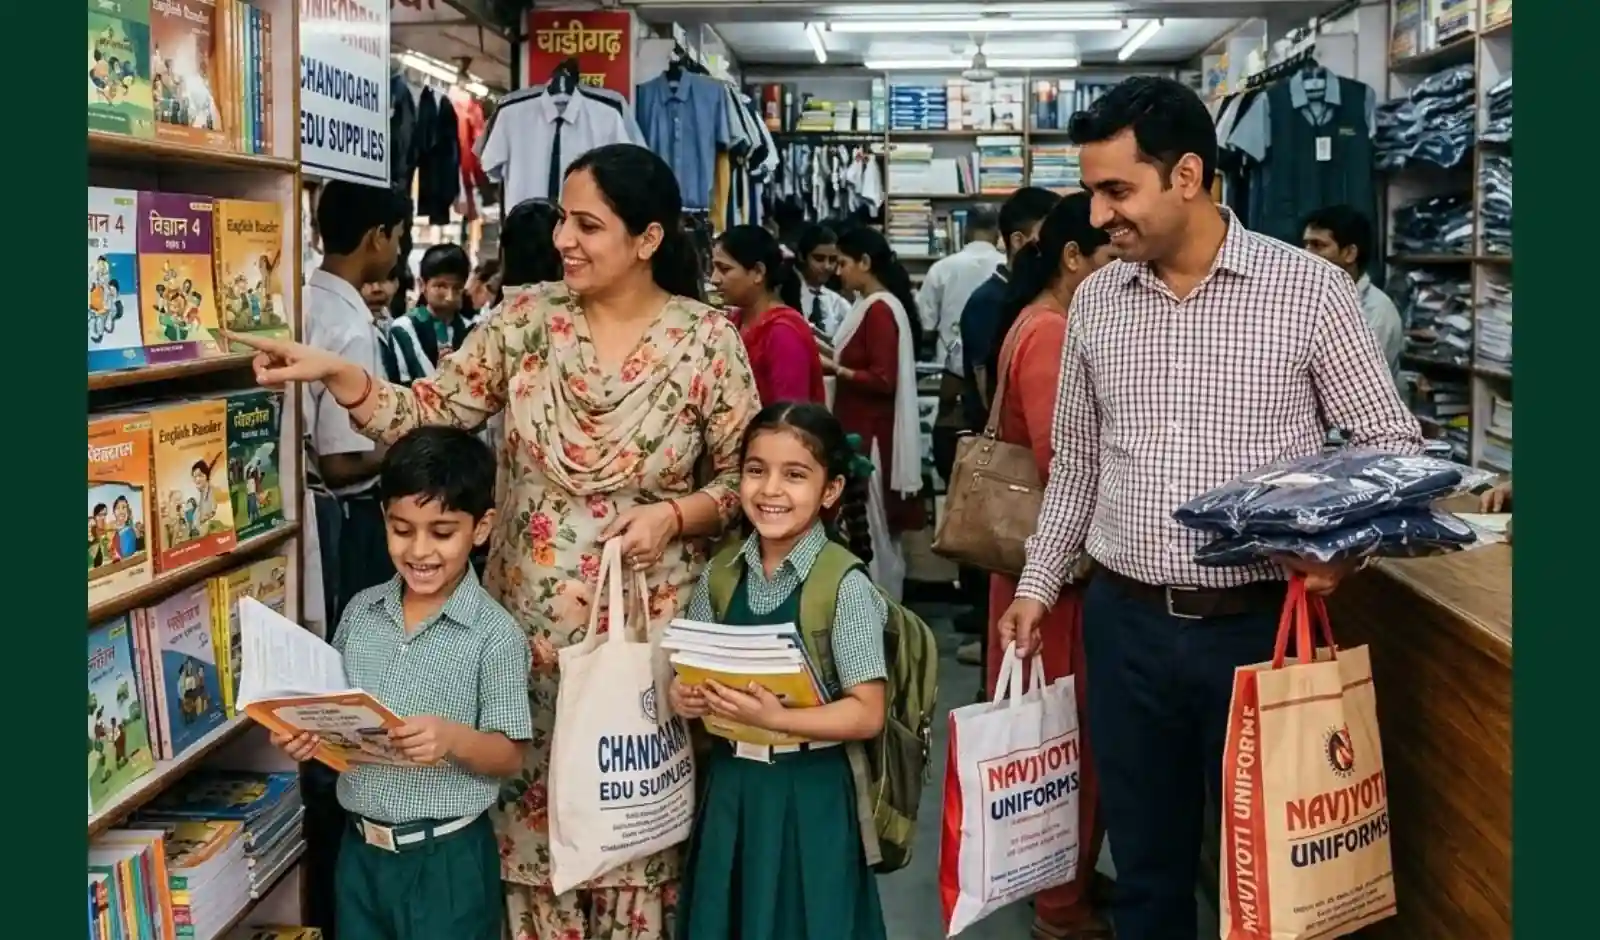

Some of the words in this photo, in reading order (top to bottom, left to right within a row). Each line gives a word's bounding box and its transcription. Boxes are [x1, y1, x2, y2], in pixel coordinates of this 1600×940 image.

[300, 110, 325, 149] EDU
[329, 118, 384, 162] SUPPLIES
[115, 215, 125, 234] 4
[192, 218, 201, 236] 4
[600, 780, 634, 801] EDU
[988, 738, 1078, 792] NAVJYOTI
[991, 771, 1079, 820] UNIFORMS
[1285, 770, 1386, 831] NAVJYOTI
[1291, 814, 1388, 867] UNIFORMS
[1234, 825, 1259, 934] NAVJYOTI
